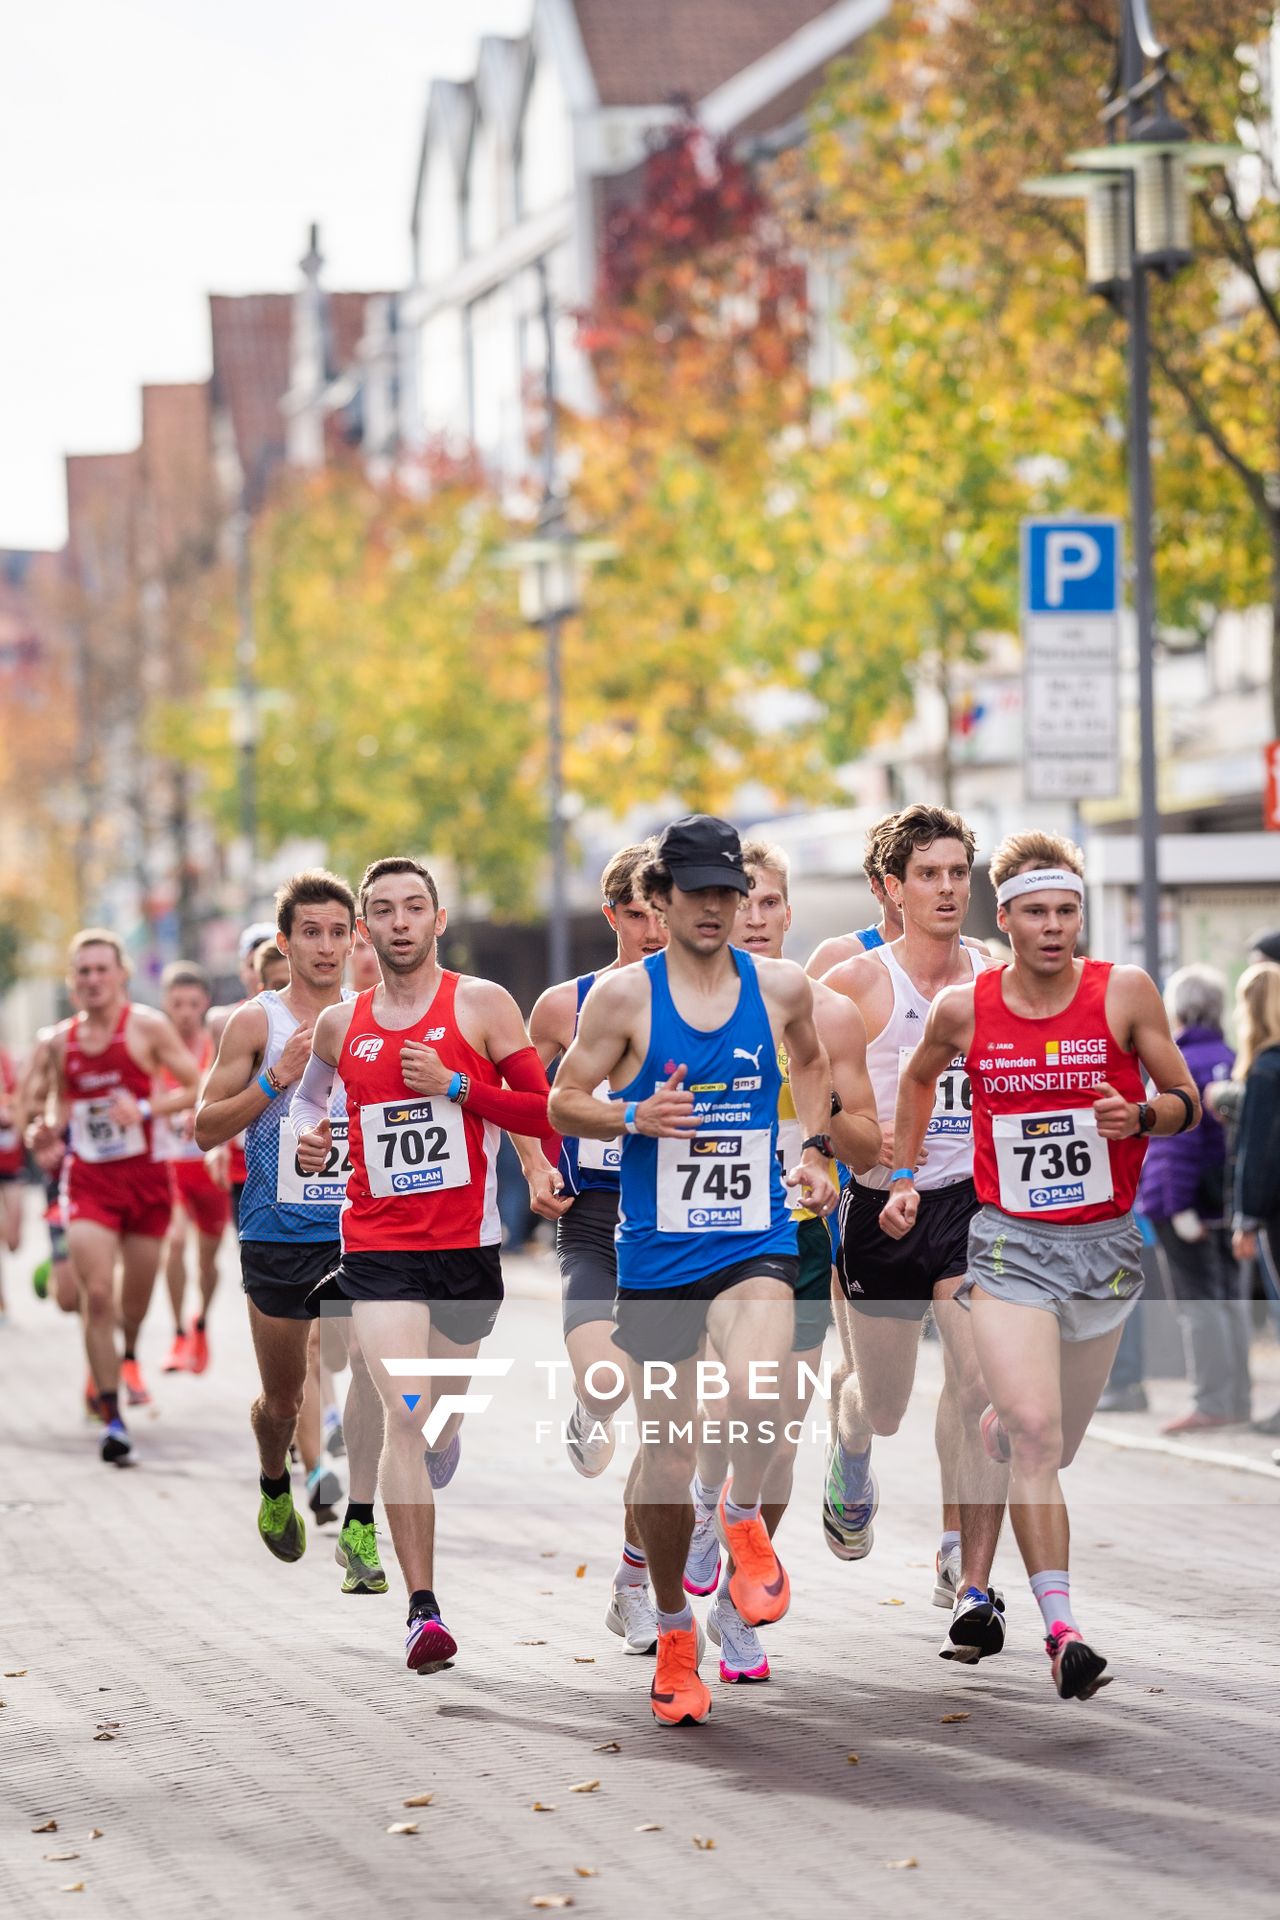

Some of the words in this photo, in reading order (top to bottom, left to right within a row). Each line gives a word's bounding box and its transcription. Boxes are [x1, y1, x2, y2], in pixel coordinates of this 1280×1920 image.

[1044, 530, 1102, 608] P
[1060, 1039, 1107, 1054] BIGGE
[979, 1059, 993, 1070] SG
[995, 1056, 1036, 1069] Wenden
[1061, 1053, 1107, 1065] ENERGIE
[734, 1080, 756, 1089] gmg
[935, 1076, 974, 1111] 16
[410, 1108, 429, 1120] GLS
[942, 1119, 970, 1128] PLAN
[1049, 1121, 1070, 1134] GLS
[377, 1126, 451, 1168] 702
[716, 1141, 739, 1153] GLS
[1013, 1140, 1092, 1182] 736
[412, 1170, 441, 1183] PLAN
[676, 1163, 752, 1201] 745
[1051, 1186, 1082, 1198] PLAN
[710, 1210, 740, 1220] PLAN
